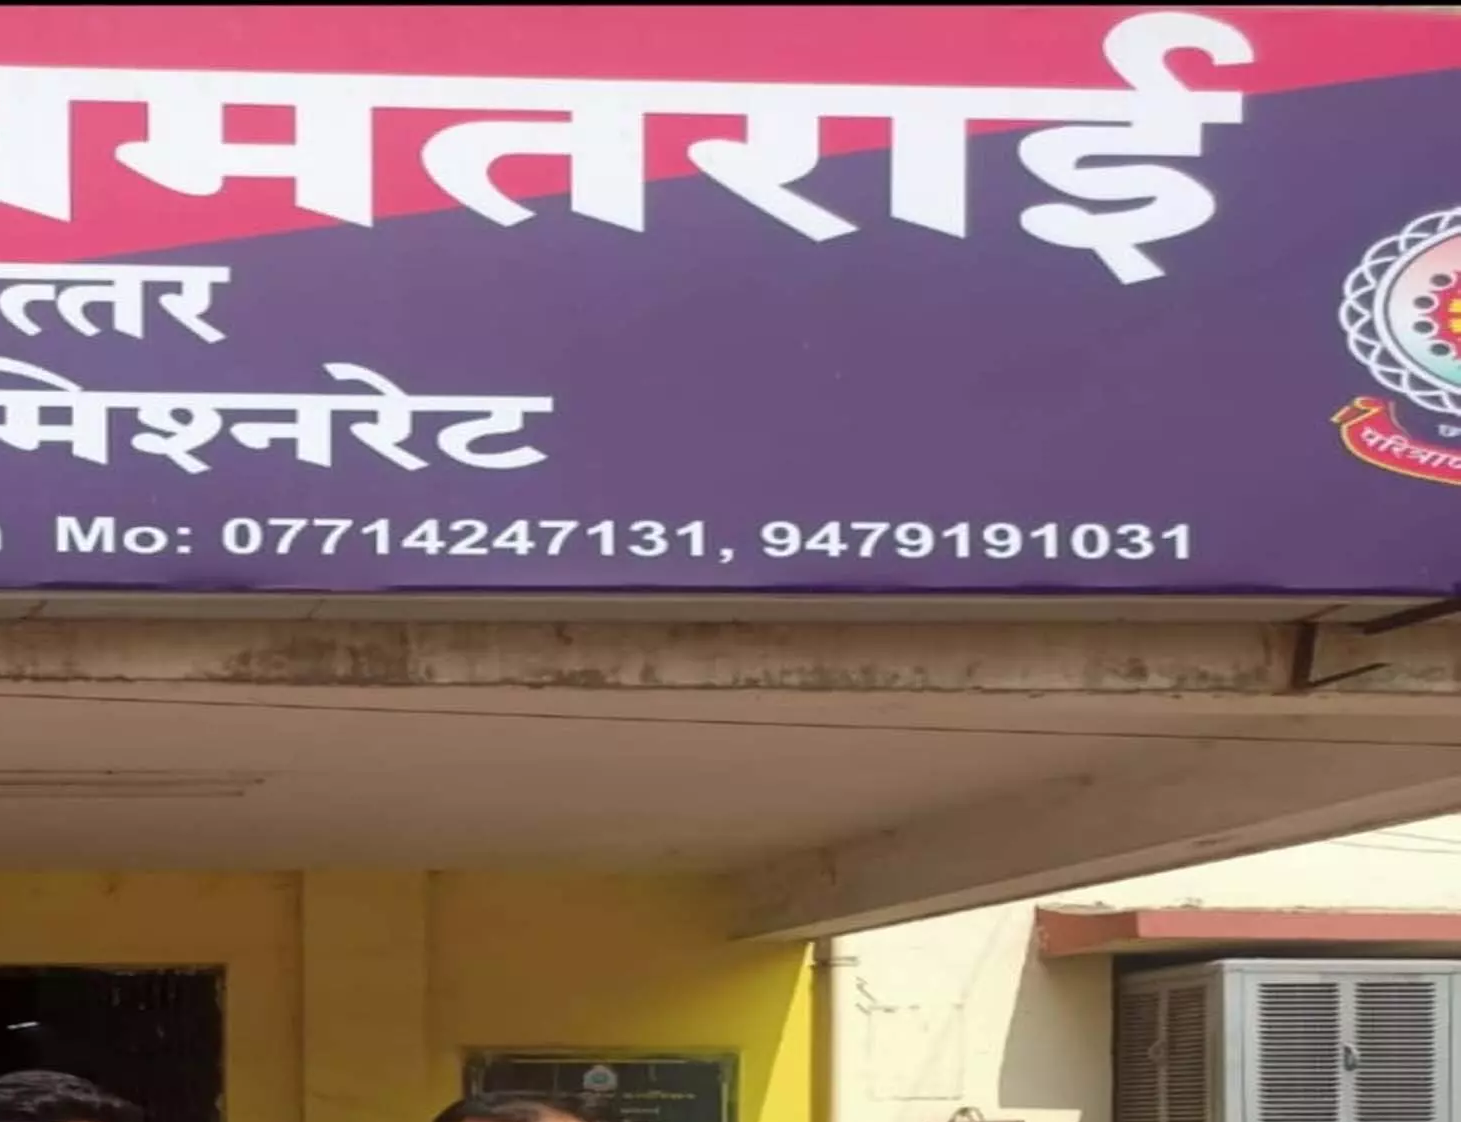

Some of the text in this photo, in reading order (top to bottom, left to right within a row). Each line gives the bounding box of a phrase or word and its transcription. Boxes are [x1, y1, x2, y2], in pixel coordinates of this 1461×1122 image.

[56, 515, 192, 554] Mo:
[222, 516, 734, 563] 07714247131,
[761, 521, 1190, 560] 9479191031
